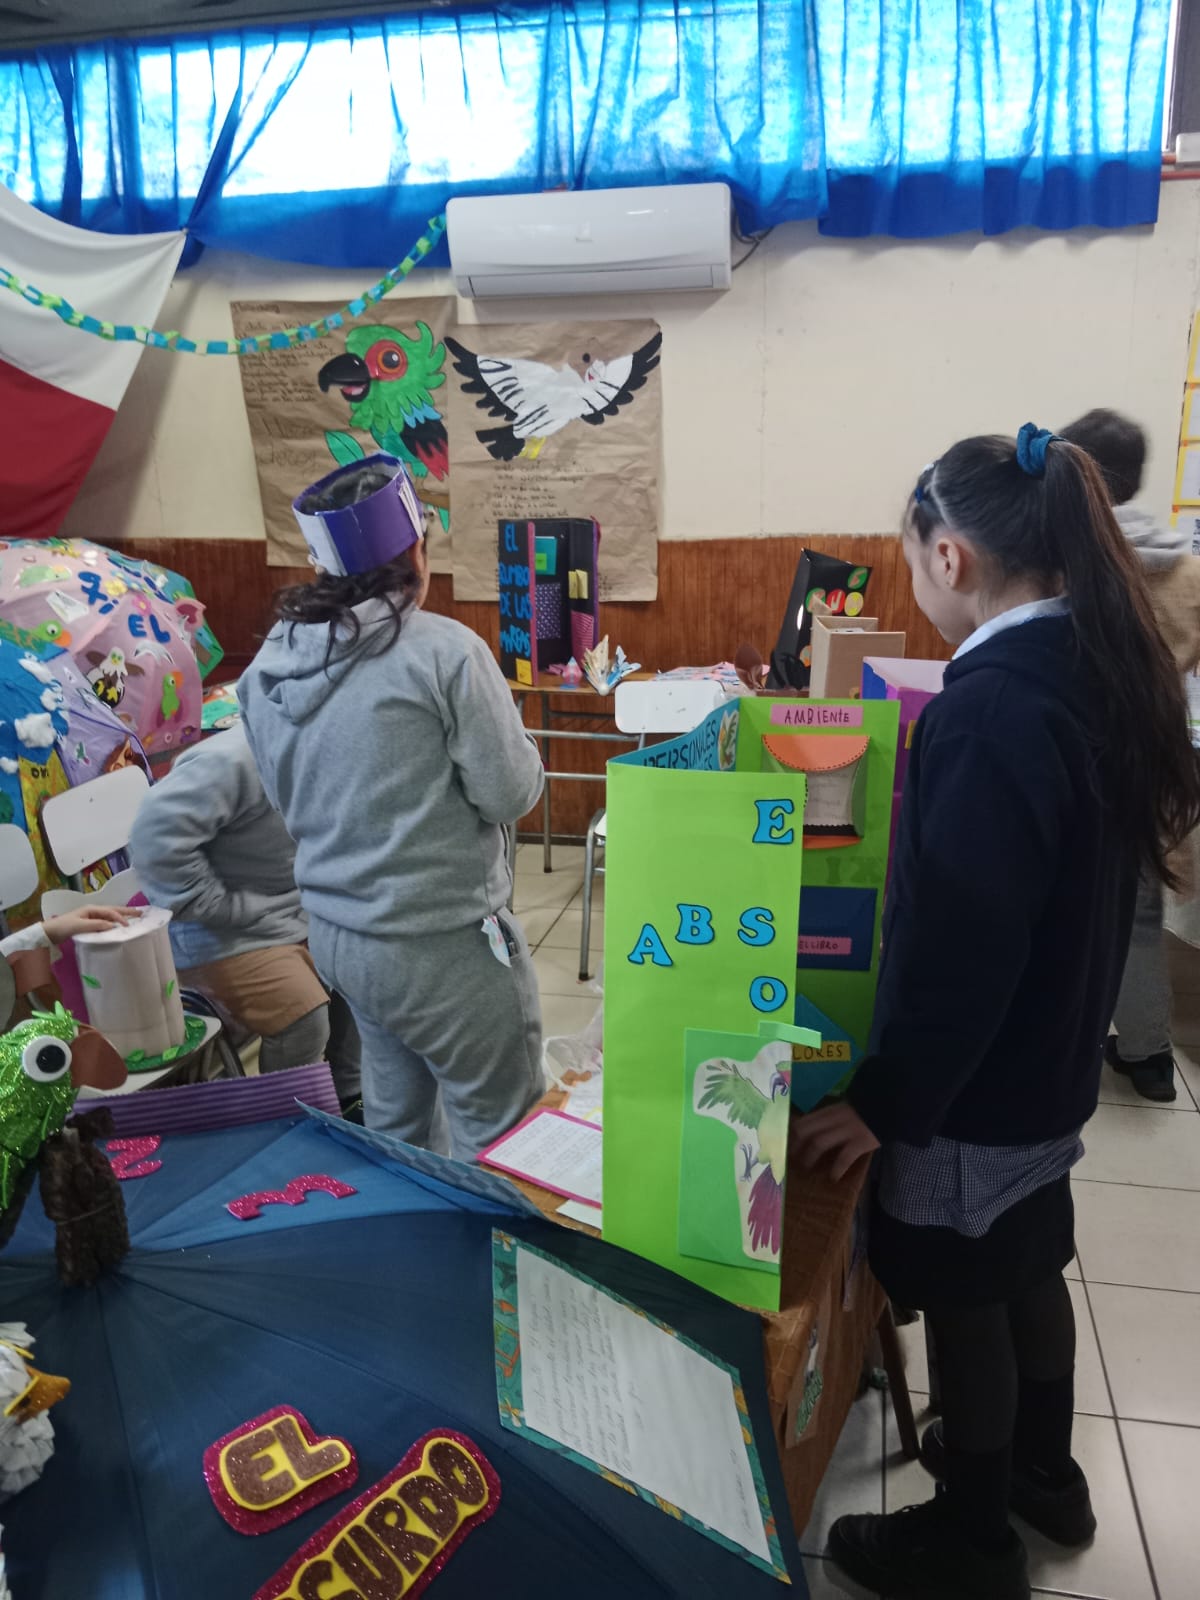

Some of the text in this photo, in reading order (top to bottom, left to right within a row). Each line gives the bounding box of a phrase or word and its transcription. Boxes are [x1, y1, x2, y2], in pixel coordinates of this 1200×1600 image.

[504, 523, 518, 552] EL
[127, 614, 172, 644] EL
[752, 798, 795, 845] E
[221, 1414, 350, 1510] EL
